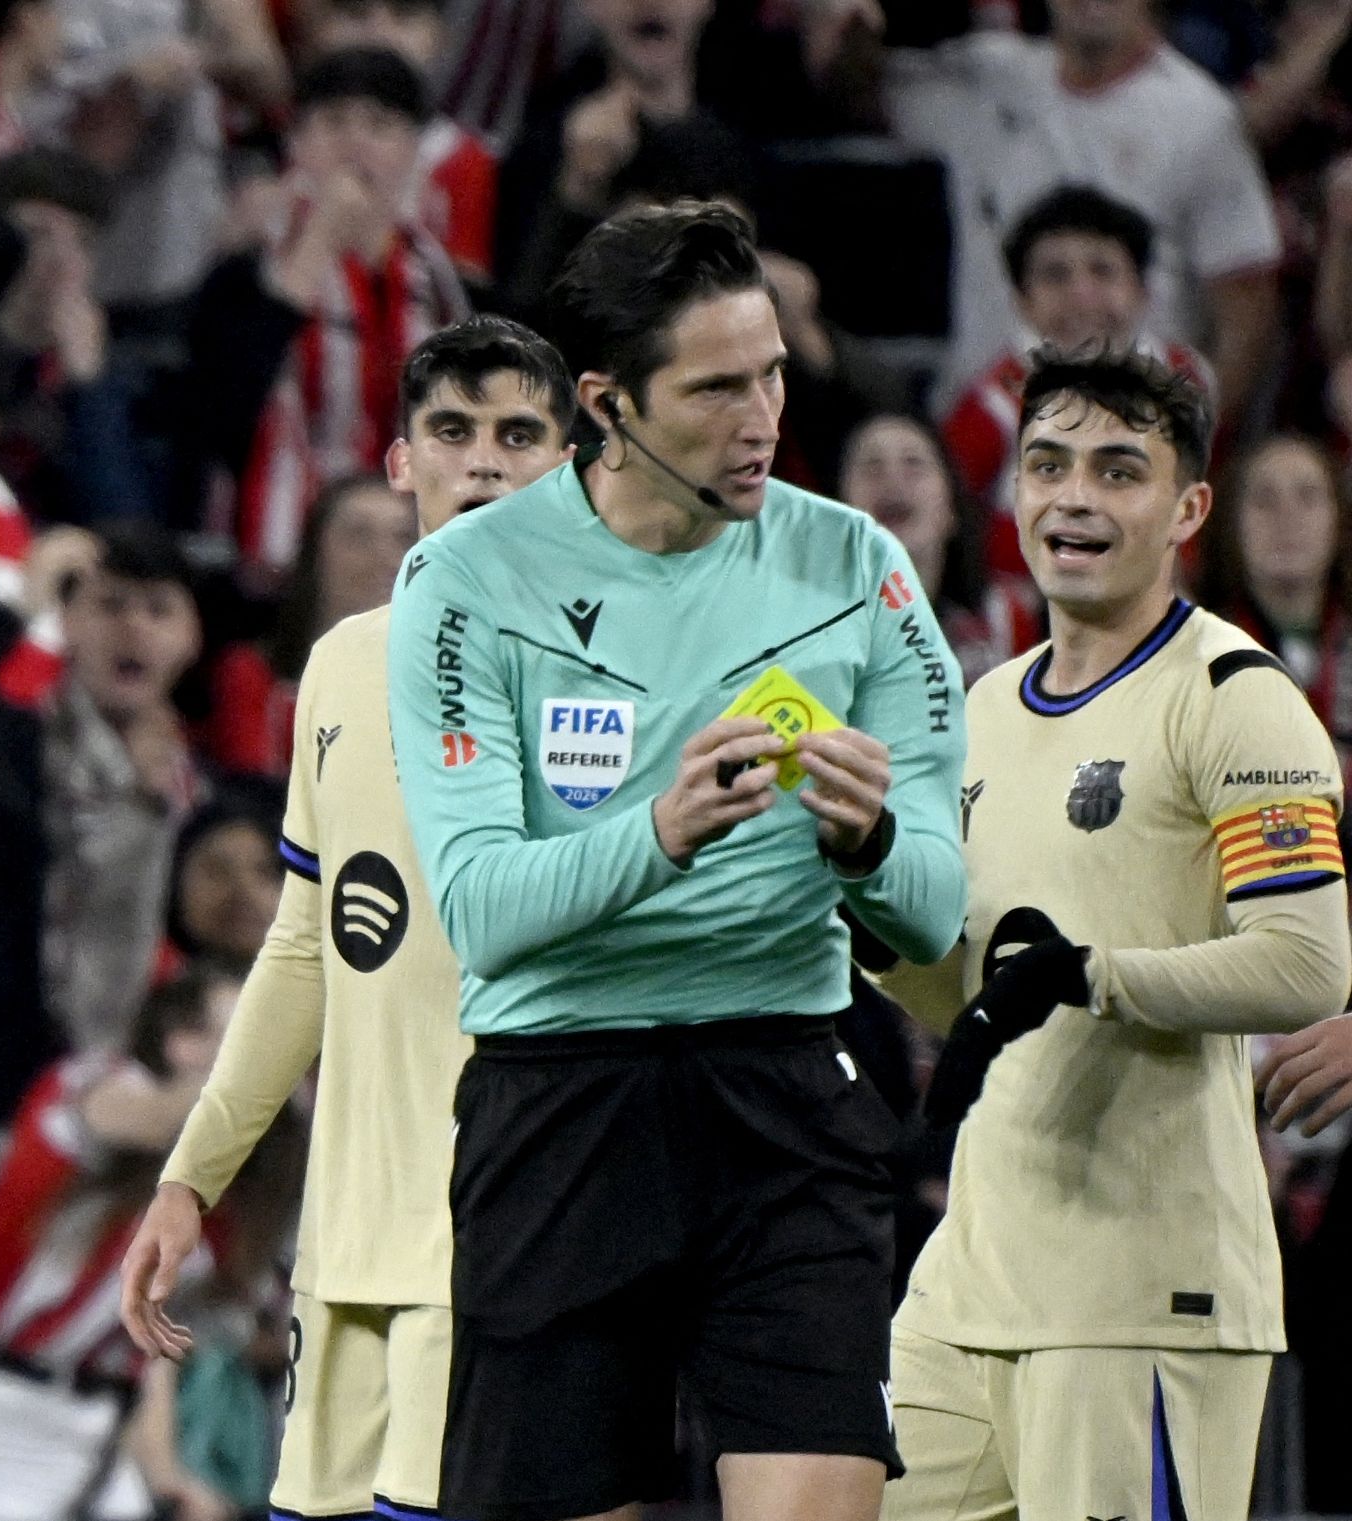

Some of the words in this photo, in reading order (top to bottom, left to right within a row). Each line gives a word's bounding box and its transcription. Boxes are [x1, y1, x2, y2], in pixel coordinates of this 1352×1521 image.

[435, 606, 469, 729] WÜRTH
[550, 707, 624, 735] FIFA
[548, 751, 622, 769] REFEREE
[565, 788, 600, 802] 2026
